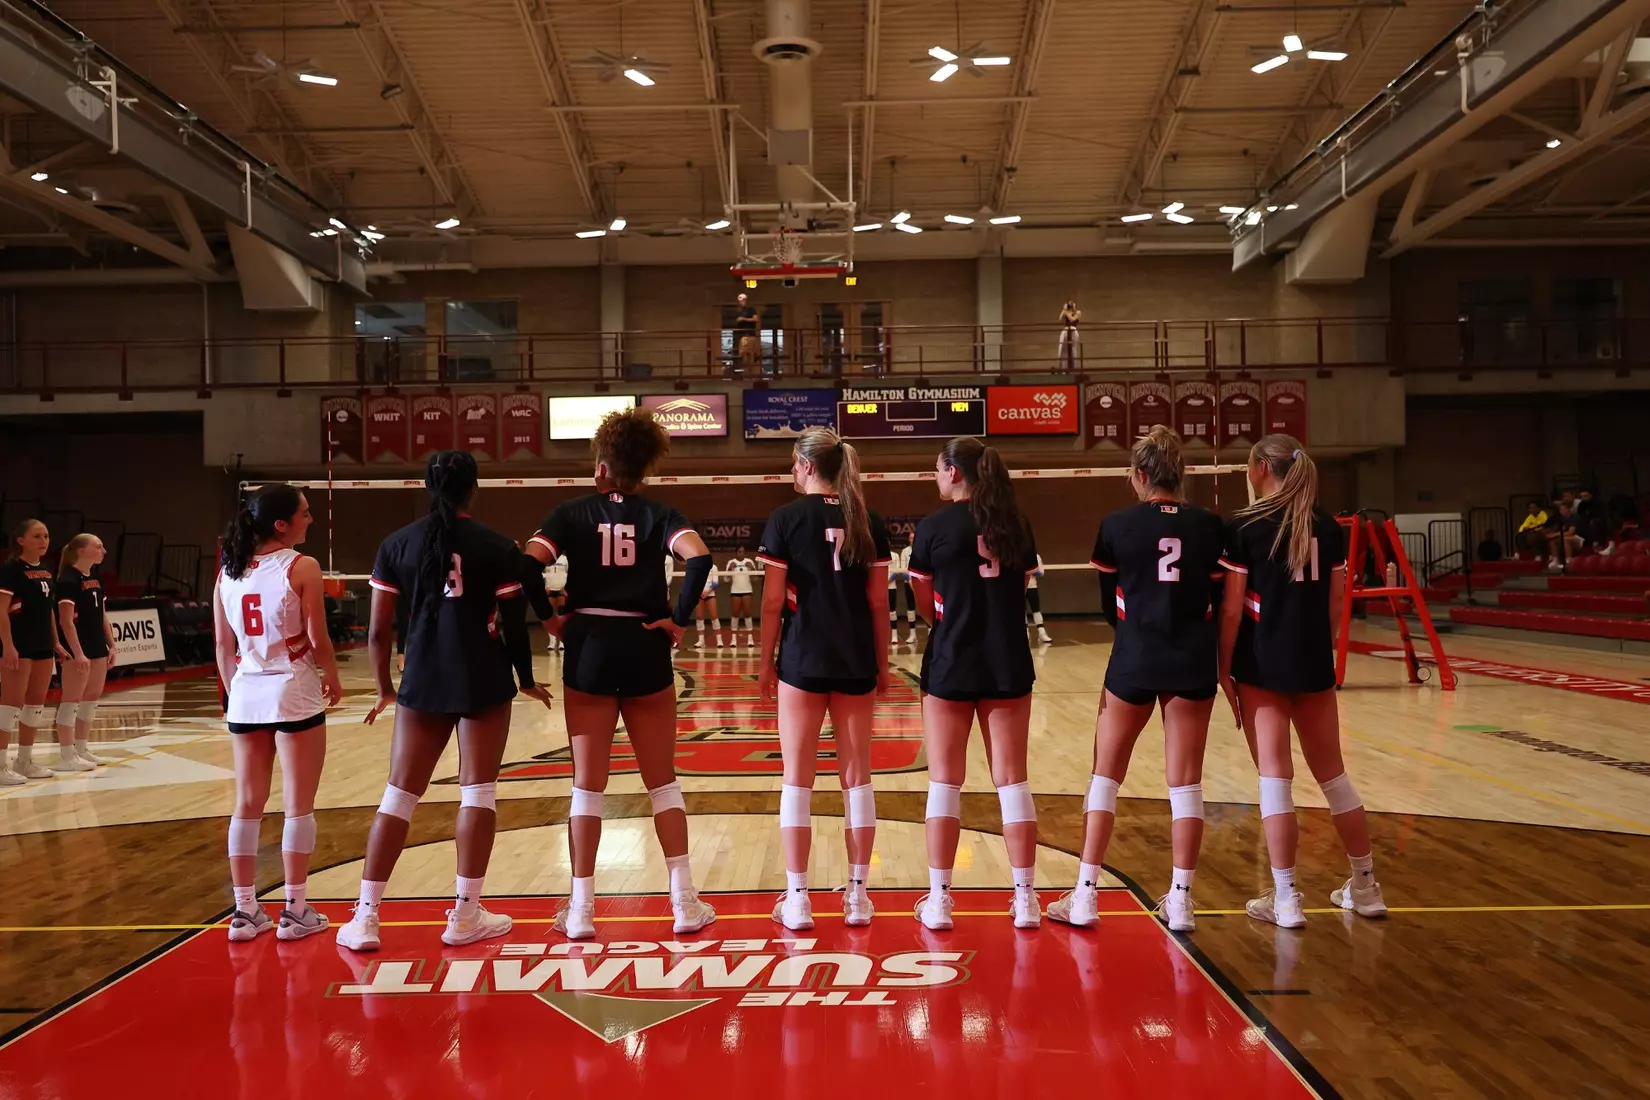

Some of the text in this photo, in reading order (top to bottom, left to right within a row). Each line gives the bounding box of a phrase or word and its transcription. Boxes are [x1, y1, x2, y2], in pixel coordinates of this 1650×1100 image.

[842, 387, 980, 400] HAMILTON GYMNASIUM
[374, 412, 400, 421] WNIT
[423, 411, 440, 420] NIT
[512, 409, 532, 417] WAC
[847, 404, 877, 413] DENVER
[998, 407, 1061, 419] canvas
[653, 413, 715, 422] PANORAMA
[597, 523, 635, 567] 16
[825, 528, 845, 571] 7
[1158, 537, 1182, 582] 2
[40, 581, 50, 597] 4
[92, 591, 99, 607] 1
[241, 593, 264, 637] 6
[110, 620, 155, 642] DAVIS
[500, 938, 817, 955] LEAGUE
[339, 952, 964, 993] SUMMIT
[736, 991, 898, 1006] THE
